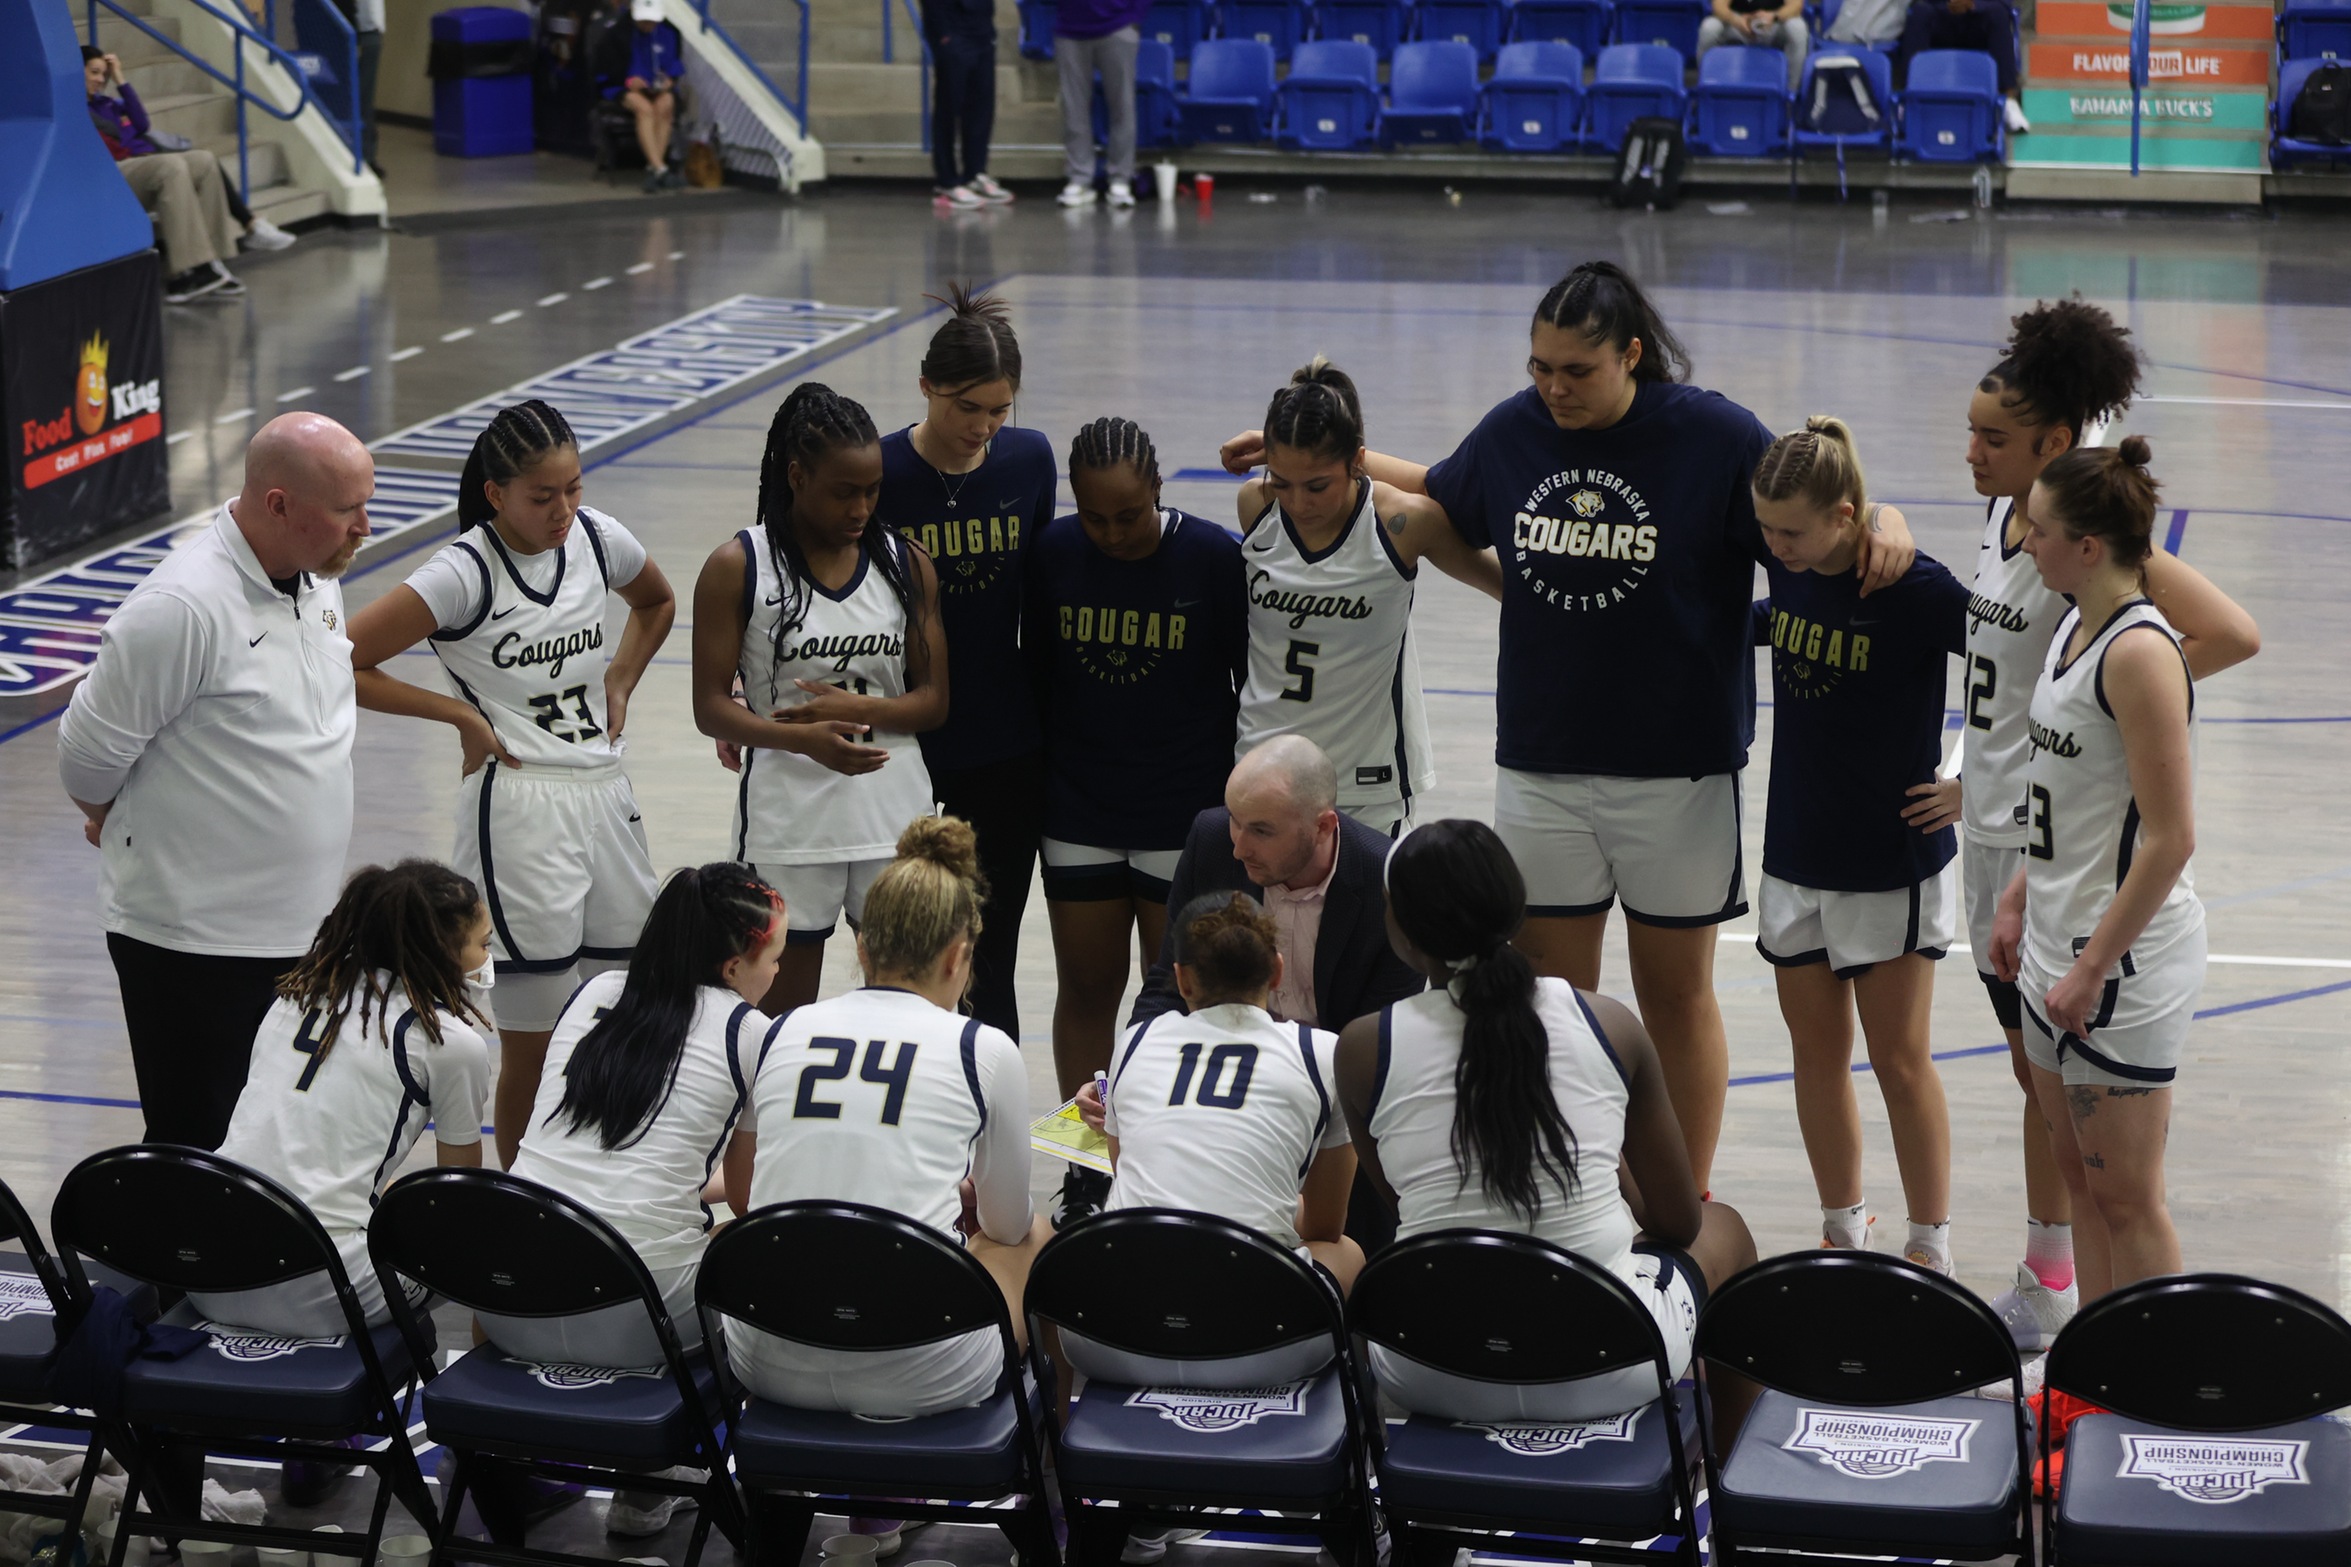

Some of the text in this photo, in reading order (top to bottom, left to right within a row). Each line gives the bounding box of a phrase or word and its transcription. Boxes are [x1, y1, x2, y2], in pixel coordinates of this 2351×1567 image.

[2073, 53, 2220, 75] FLAVO OUR LIFE
[2070, 97, 2213, 117] BAHAMA BUCK'S
[22, 379, 160, 455] Food King
[1525, 469, 1650, 522] WESTERN NEBRASKA
[1514, 511, 1658, 562] COUGARS
[1249, 570, 1372, 629] Cougars
[1516, 551, 1648, 611] BASKETBALL
[1060, 606, 1186, 650] COUGAR
[1770, 606, 1870, 671] COUGAR
[1966, 591, 2029, 635] ugars
[492, 622, 603, 679] Cougars
[775, 621, 901, 672] Cougars
[1280, 639, 1319, 703] 5
[528, 684, 603, 743] 23
[1964, 651, 1997, 731] 2
[2027, 716, 2082, 762] ugars
[2027, 781, 2054, 861] 3
[292, 1006, 337, 1092] 4
[792, 1036, 918, 1127] 24
[1168, 1043, 1259, 1110] 10
[1174, 1402, 1258, 1420] NJCAA
[1500, 1427, 1586, 1444] NJCAA
[1815, 1421, 1952, 1441] CHAMPIONSHIP
[1813, 1431, 1948, 1446] WOMEN'S BASKETBALL
[1832, 1447, 1919, 1466] NJCAA
[2144, 1446, 2285, 1462] CHAMPIONSHIP
[2144, 1457, 2223, 1466] BASKETBALL
[2171, 1470, 2255, 1489] NJCAA
